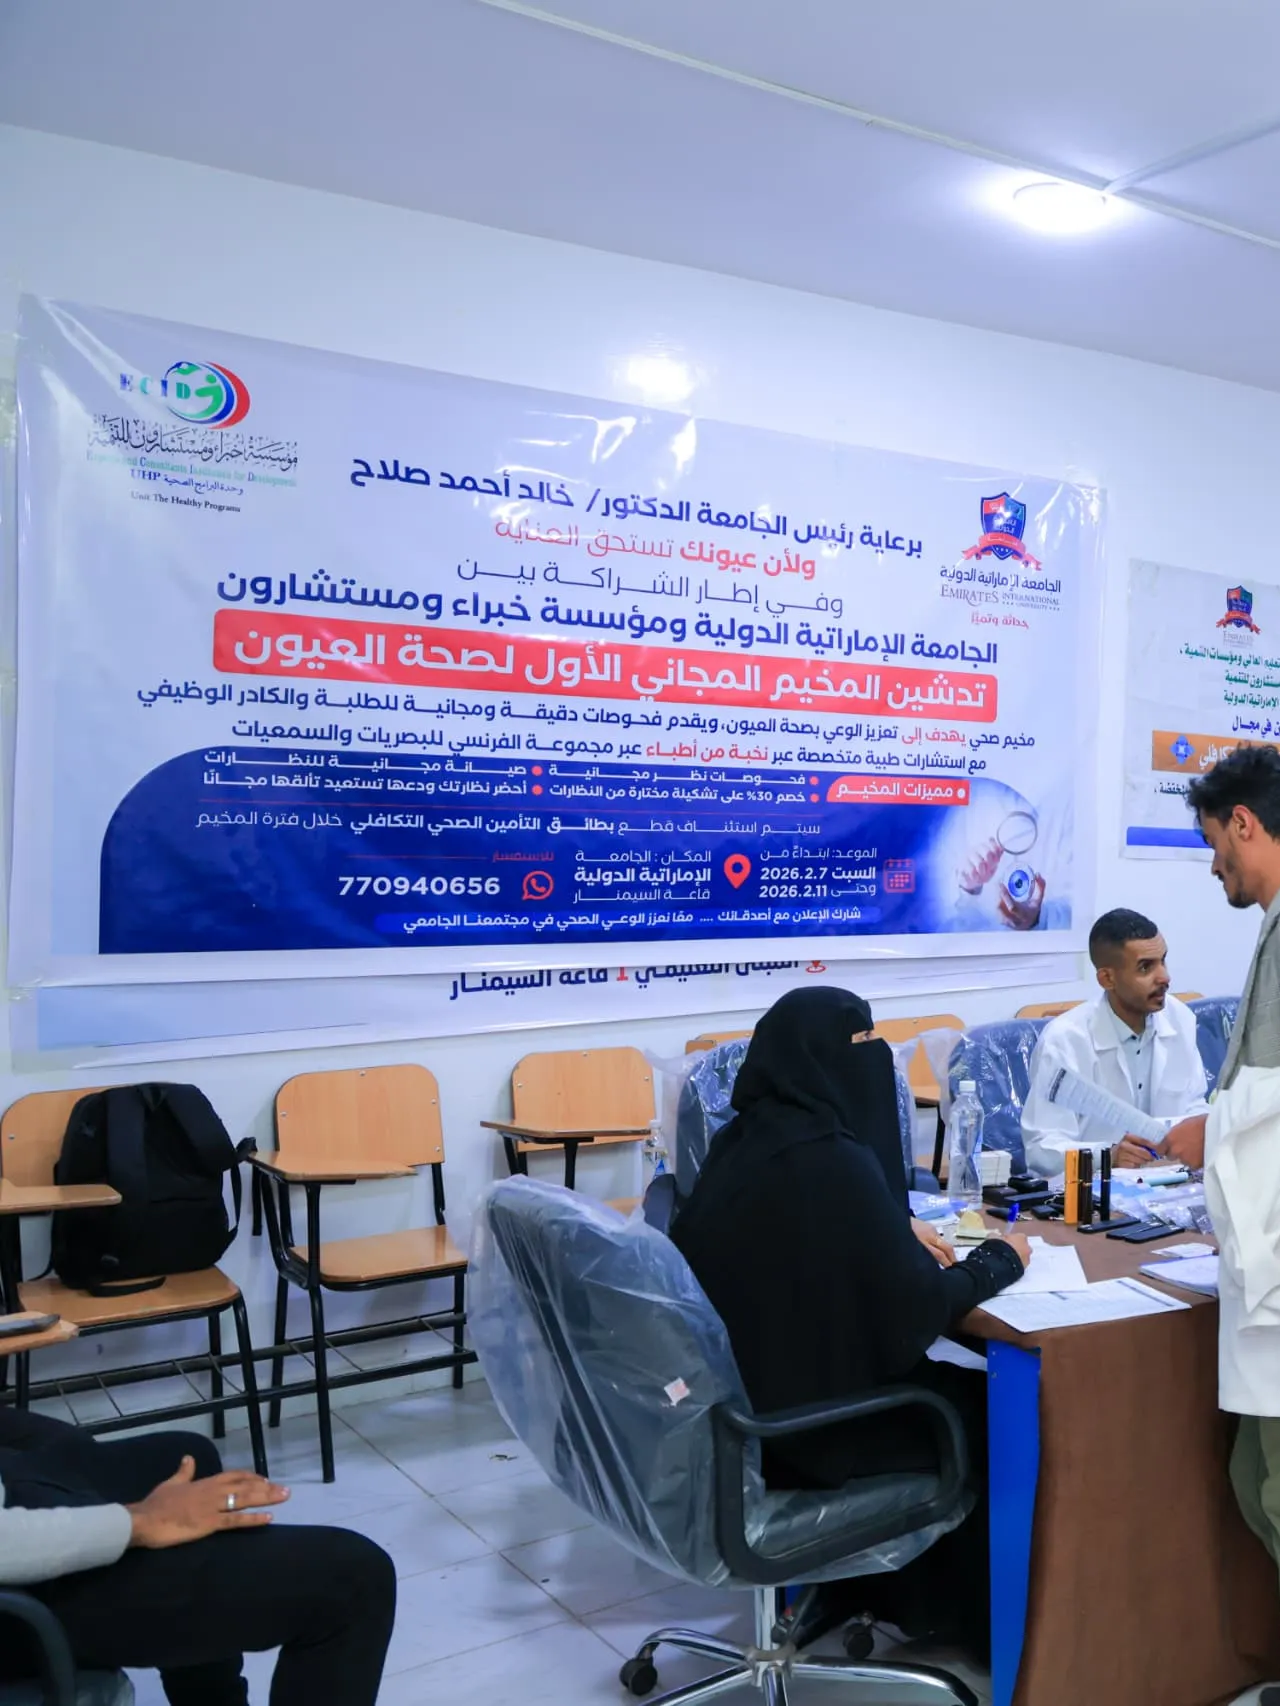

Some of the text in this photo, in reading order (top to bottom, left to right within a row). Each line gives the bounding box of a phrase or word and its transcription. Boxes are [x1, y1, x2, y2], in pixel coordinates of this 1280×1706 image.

[130, 469, 161, 481] UHP
[350, 458, 430, 487] صلاح
[439, 470, 511, 497] أحمد
[130, 491, 151, 501] Unit
[154, 494, 169, 504] The
[171, 496, 203, 509] Healthy
[518, 481, 574, 507] خالد
[697, 502, 787, 539] الجامعة
[793, 522, 854, 549] رئيس
[860, 525, 922, 558] برعاية
[587, 527, 816, 580] ولأن عيونك تستحق
[940, 565, 976, 583] الدولية
[457, 558, 843, 619] وفي إطار الشراكة بين
[1021, 577, 1061, 595] الجامعة
[941, 585, 999, 607] EMIRATES
[217, 568, 998, 668] الجامعة الإماراتية الدولية ومؤسسة خبراء ومستشارون
[234, 630, 987, 711] تدشين المخيم المجاني الأول لصحة العيون
[137, 679, 233, 708] الوظيفي
[237, 686, 309, 710] والكادر
[314, 688, 399, 713] للطلبة
[403, 694, 495, 721] ومجانية
[500, 702, 578, 726] دقيقة
[582, 708, 663, 729] فحوصات
[666, 713, 718, 735] ويقدم
[1261, 718, 1272, 738] في
[780, 718, 820, 742] بصحة
[823, 723, 862, 743] الوعي
[864, 725, 899, 742] تعزيز
[902, 727, 922, 746] إلى
[925, 728, 967, 747] يهدف
[232, 720, 987, 775] مع استشارات طبية متخصصة عبر نخبة من أطباء عبر مجموعة الفرنسي للبصريات والسمعيات
[969, 733, 999, 751] صحي
[1002, 731, 1035, 750] مخيم
[204, 751, 324, 766] للنظارات
[272, 772, 320, 789] تألقها
[324, 777, 384, 793] تستعيد
[387, 777, 435, 794] ودعها
[439, 779, 490, 794] نظارتك
[493, 780, 527, 796] أحضر
[836, 780, 953, 798] مميزات المخيم
[550, 784, 806, 804] خصم على تشكيلة مختارة من النظارات
[195, 811, 257, 828] المخيم
[262, 811, 300, 829] فترة
[303, 813, 342, 829] خلال
[350, 814, 424, 835] التكافلي
[427, 815, 482, 836] الصحي
[485, 813, 540, 833] التأمين
[546, 815, 614, 835] بطائق
[575, 850, 651, 863] الجامعة
[574, 867, 711, 885] الإماراتية الدولية
[760, 867, 875, 883] السبت 2026.2.7
[339, 876, 500, 896] 770940656
[759, 885, 828, 898] 2026.2.11
[572, 889, 661, 903] السيمنار
[464, 914, 529, 928] مجتمعنا
[532, 914, 554, 931] في
[556, 914, 599, 931] الصحي
[601, 912, 645, 929] الوعي
[648, 912, 671, 925] نعزز
[774, 911, 790, 924] مع
[792, 908, 830, 922] الإعلان
[832, 907, 861, 920] شارك
[403, 915, 460, 933] الجامعي
